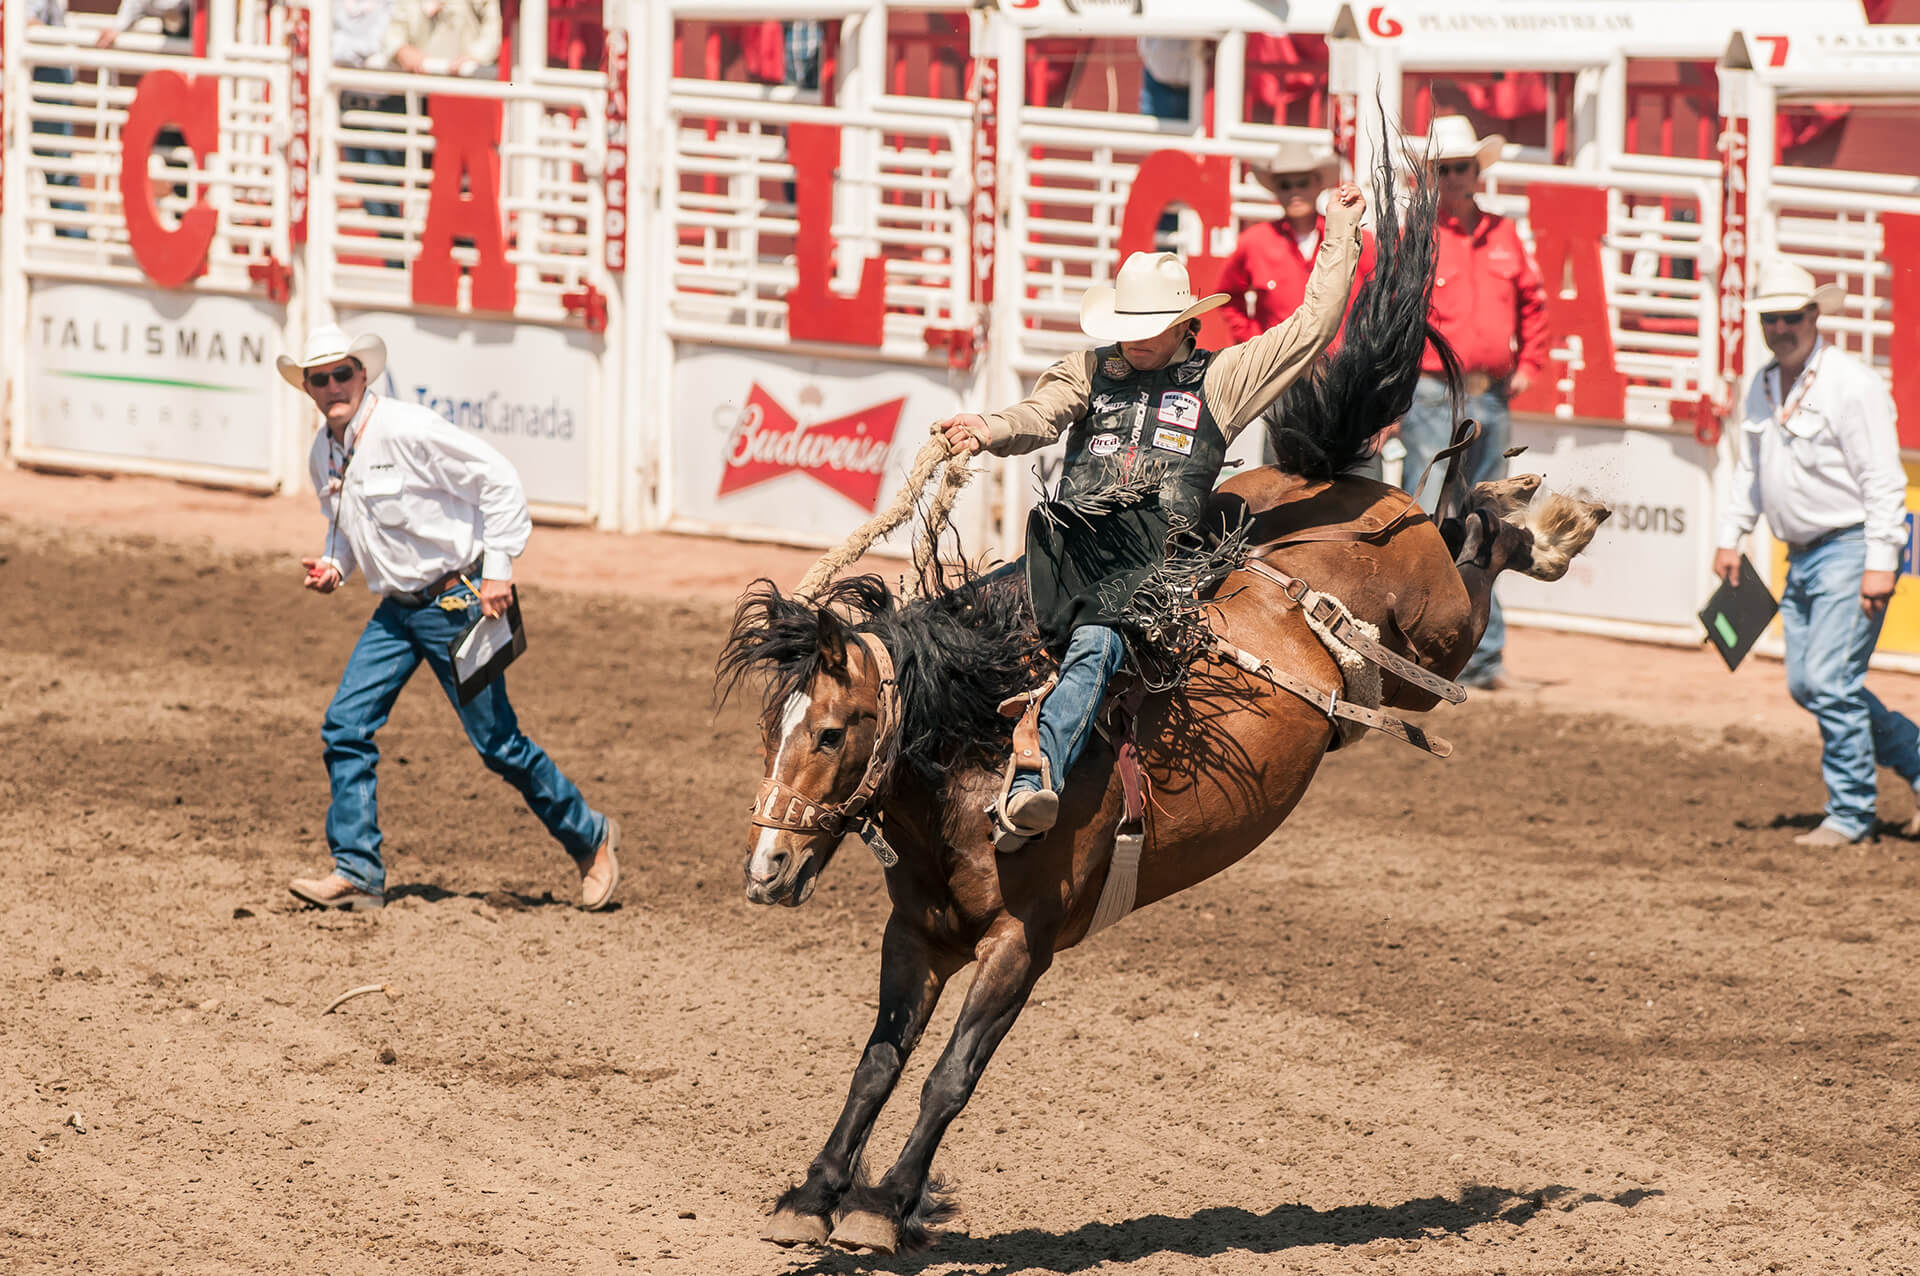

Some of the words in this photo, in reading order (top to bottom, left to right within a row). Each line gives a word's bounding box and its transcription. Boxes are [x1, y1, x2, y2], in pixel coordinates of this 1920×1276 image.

[1368, 6, 1404, 38] 6
[1419, 14, 1497, 31] PLAINS
[1502, 14, 1635, 32] MIDSTREAM
[1756, 35, 1789, 67] 7
[41, 315, 265, 365] TALISMAN
[713, 402, 905, 475] Budweiser
